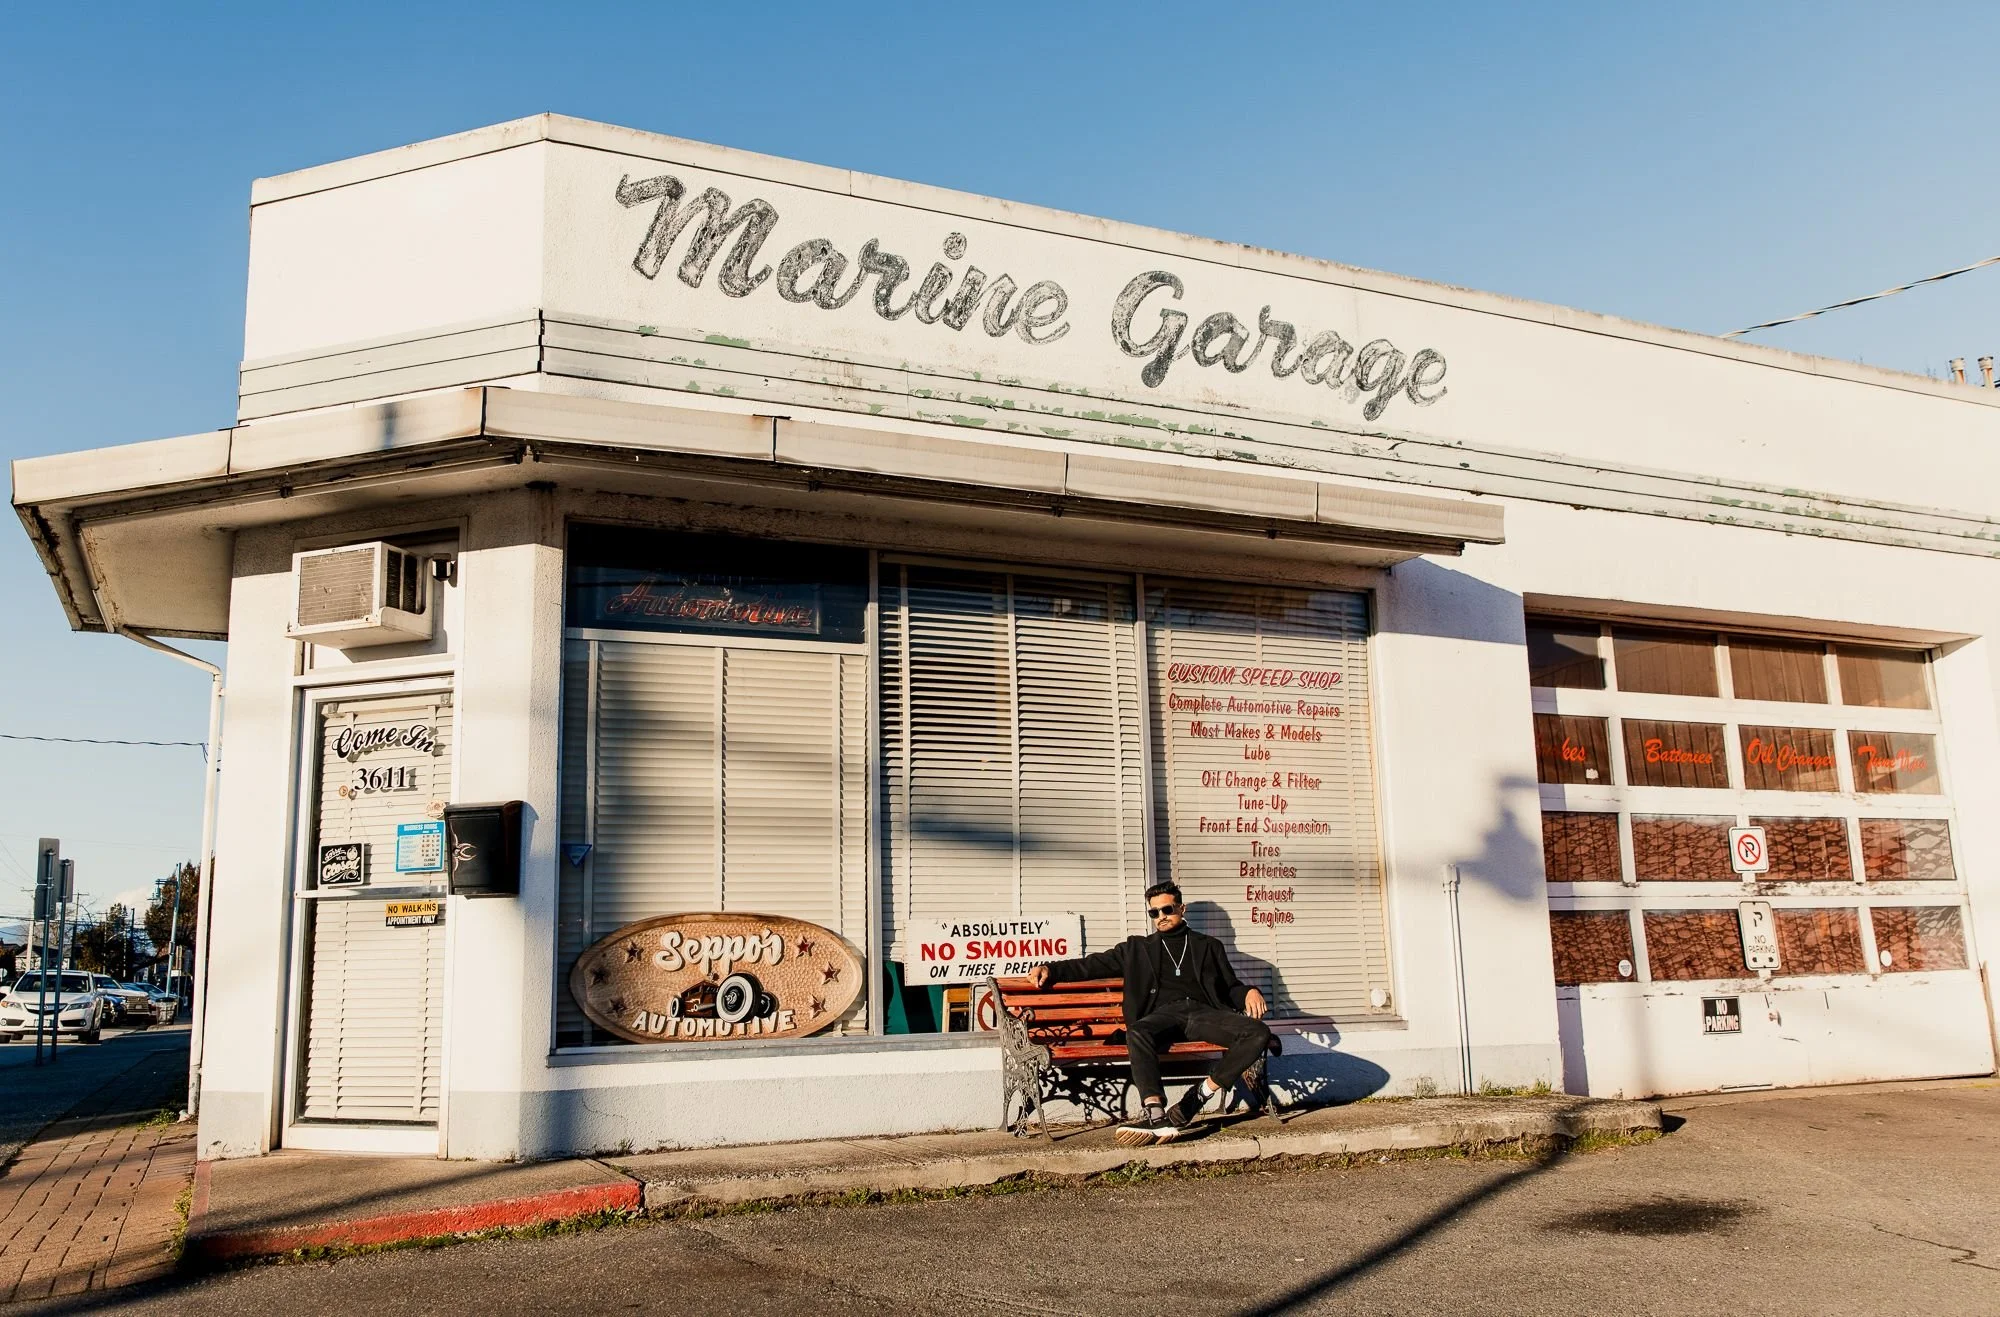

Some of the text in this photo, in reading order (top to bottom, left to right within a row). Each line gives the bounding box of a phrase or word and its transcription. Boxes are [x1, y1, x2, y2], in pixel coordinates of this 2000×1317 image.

[615, 174, 1448, 421] Marine Garage
[605, 575, 812, 627] Automotive
[1167, 663, 1341, 689] CUSTOM SPEED SHOP
[1168, 693, 1340, 719] Complete Automotive Repairs
[332, 724, 435, 758] Come In
[1190, 721, 1322, 741] Most Makes & Models
[1244, 745, 1270, 761] Lube
[1644, 738, 1713, 765] Batteries
[1747, 738, 1774, 765] Oil
[1858, 746, 1896, 773] Tune
[354, 766, 407, 791] 3611
[1202, 770, 1322, 791] Oil Change & Filter
[1238, 794, 1288, 815] Tune-Up
[1199, 817, 1330, 837] Front End Suspension
[1251, 841, 1280, 857] Tires
[1239, 862, 1296, 878] Batteries
[1246, 885, 1294, 902] Exhaust
[388, 903, 437, 914] NO WALK-INS
[1251, 907, 1294, 928] Engine
[387, 914, 436, 926] APPOINTMENT ONLY
[941, 920, 1050, 938] "ABSOLUTELY"
[921, 938, 1067, 961] NO SMOKING
[1748, 944, 1775, 954] PARKING
[1754, 935, 1767, 945] NO
[654, 929, 785, 976] Seppo's
[930, 965, 950, 978] ON
[958, 963, 996, 977] THESE
[1715, 999, 1727, 1015] NO
[1705, 1014, 1739, 1032] PARKING
